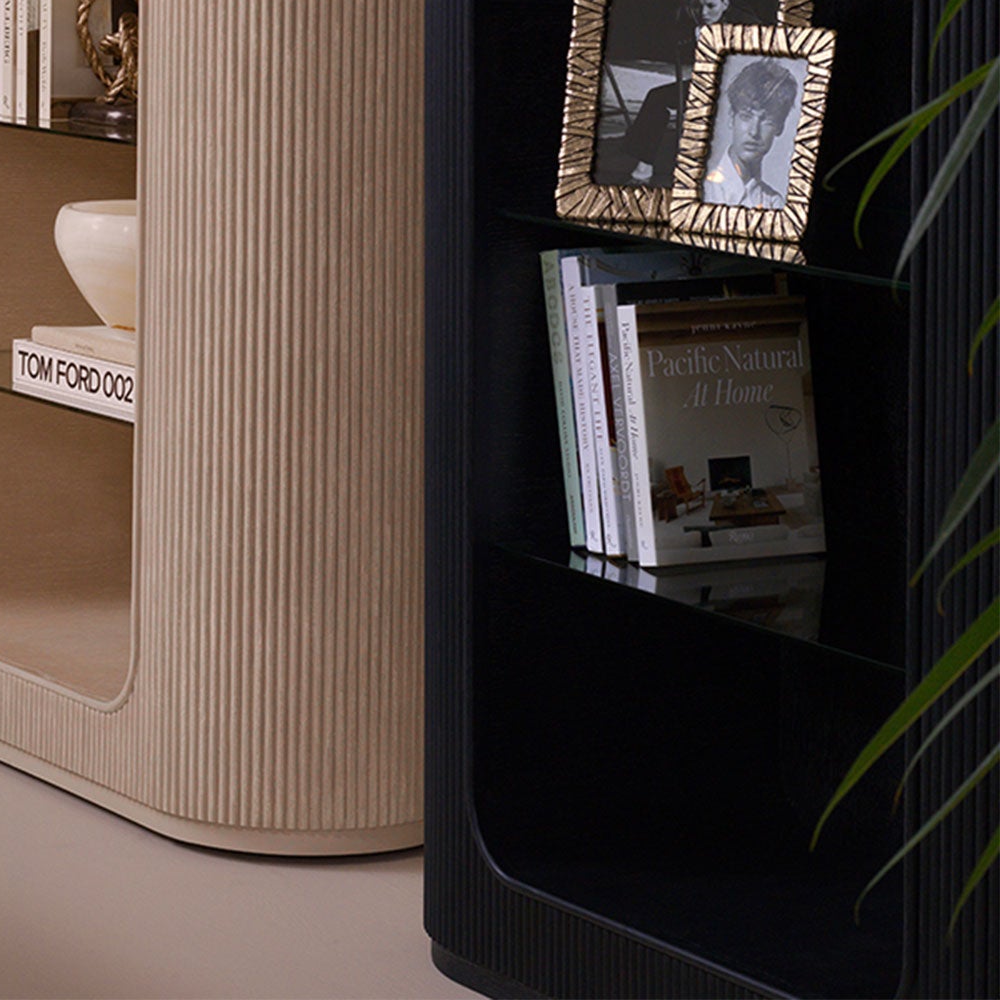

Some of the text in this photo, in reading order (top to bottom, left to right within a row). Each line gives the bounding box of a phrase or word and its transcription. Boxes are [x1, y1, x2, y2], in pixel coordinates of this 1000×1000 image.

[583, 299, 592, 324] THE
[573, 335, 581, 363] THAT
[621, 322, 632, 357] Pacific
[586, 335, 599, 402] ELEGANT
[608, 352, 620, 388] AXEL
[647, 338, 805, 378] Pacific Natural
[18, 350, 134, 403] TOM FORD 002
[576, 367, 584, 396] MADE
[625, 361, 637, 405] Natural
[683, 378, 774, 409] At Home
[579, 402, 589, 450] HISTORY
[594, 411, 602, 439] LIFE
[613, 396, 631, 501] VERVOORDT
